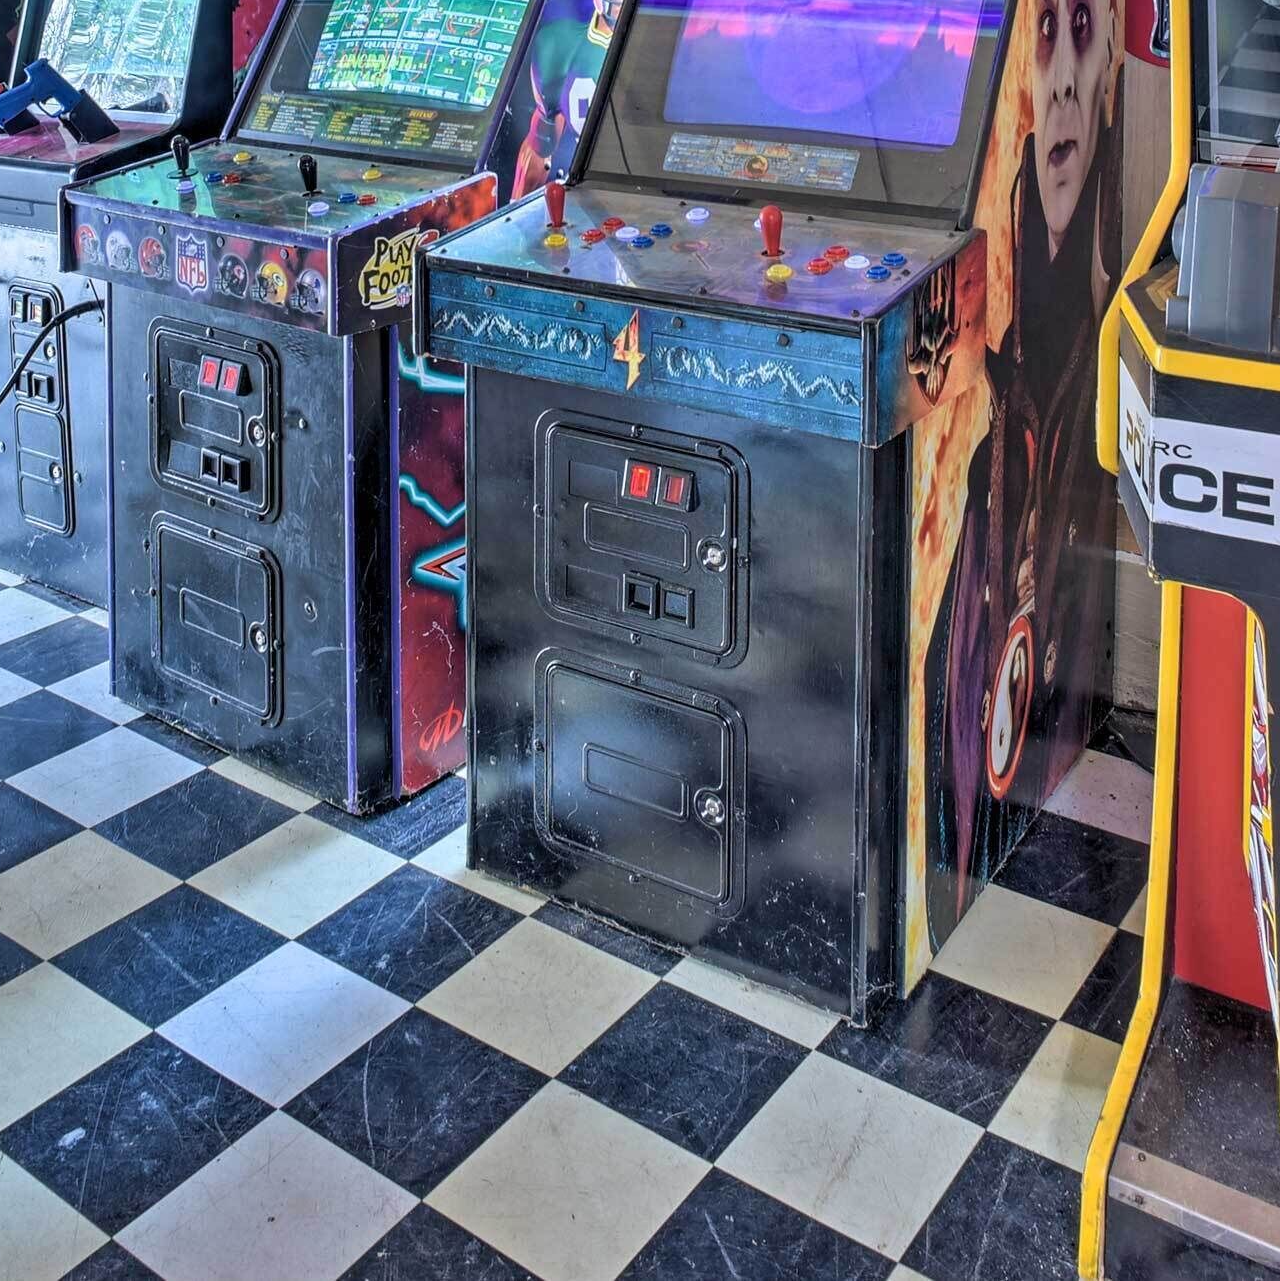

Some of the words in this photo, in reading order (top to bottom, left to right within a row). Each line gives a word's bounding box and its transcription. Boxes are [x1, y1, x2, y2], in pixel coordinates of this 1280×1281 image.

[375, 235, 416, 267] PLAY
[179, 257, 206, 285] NFL
[612, 309, 646, 390] 4
